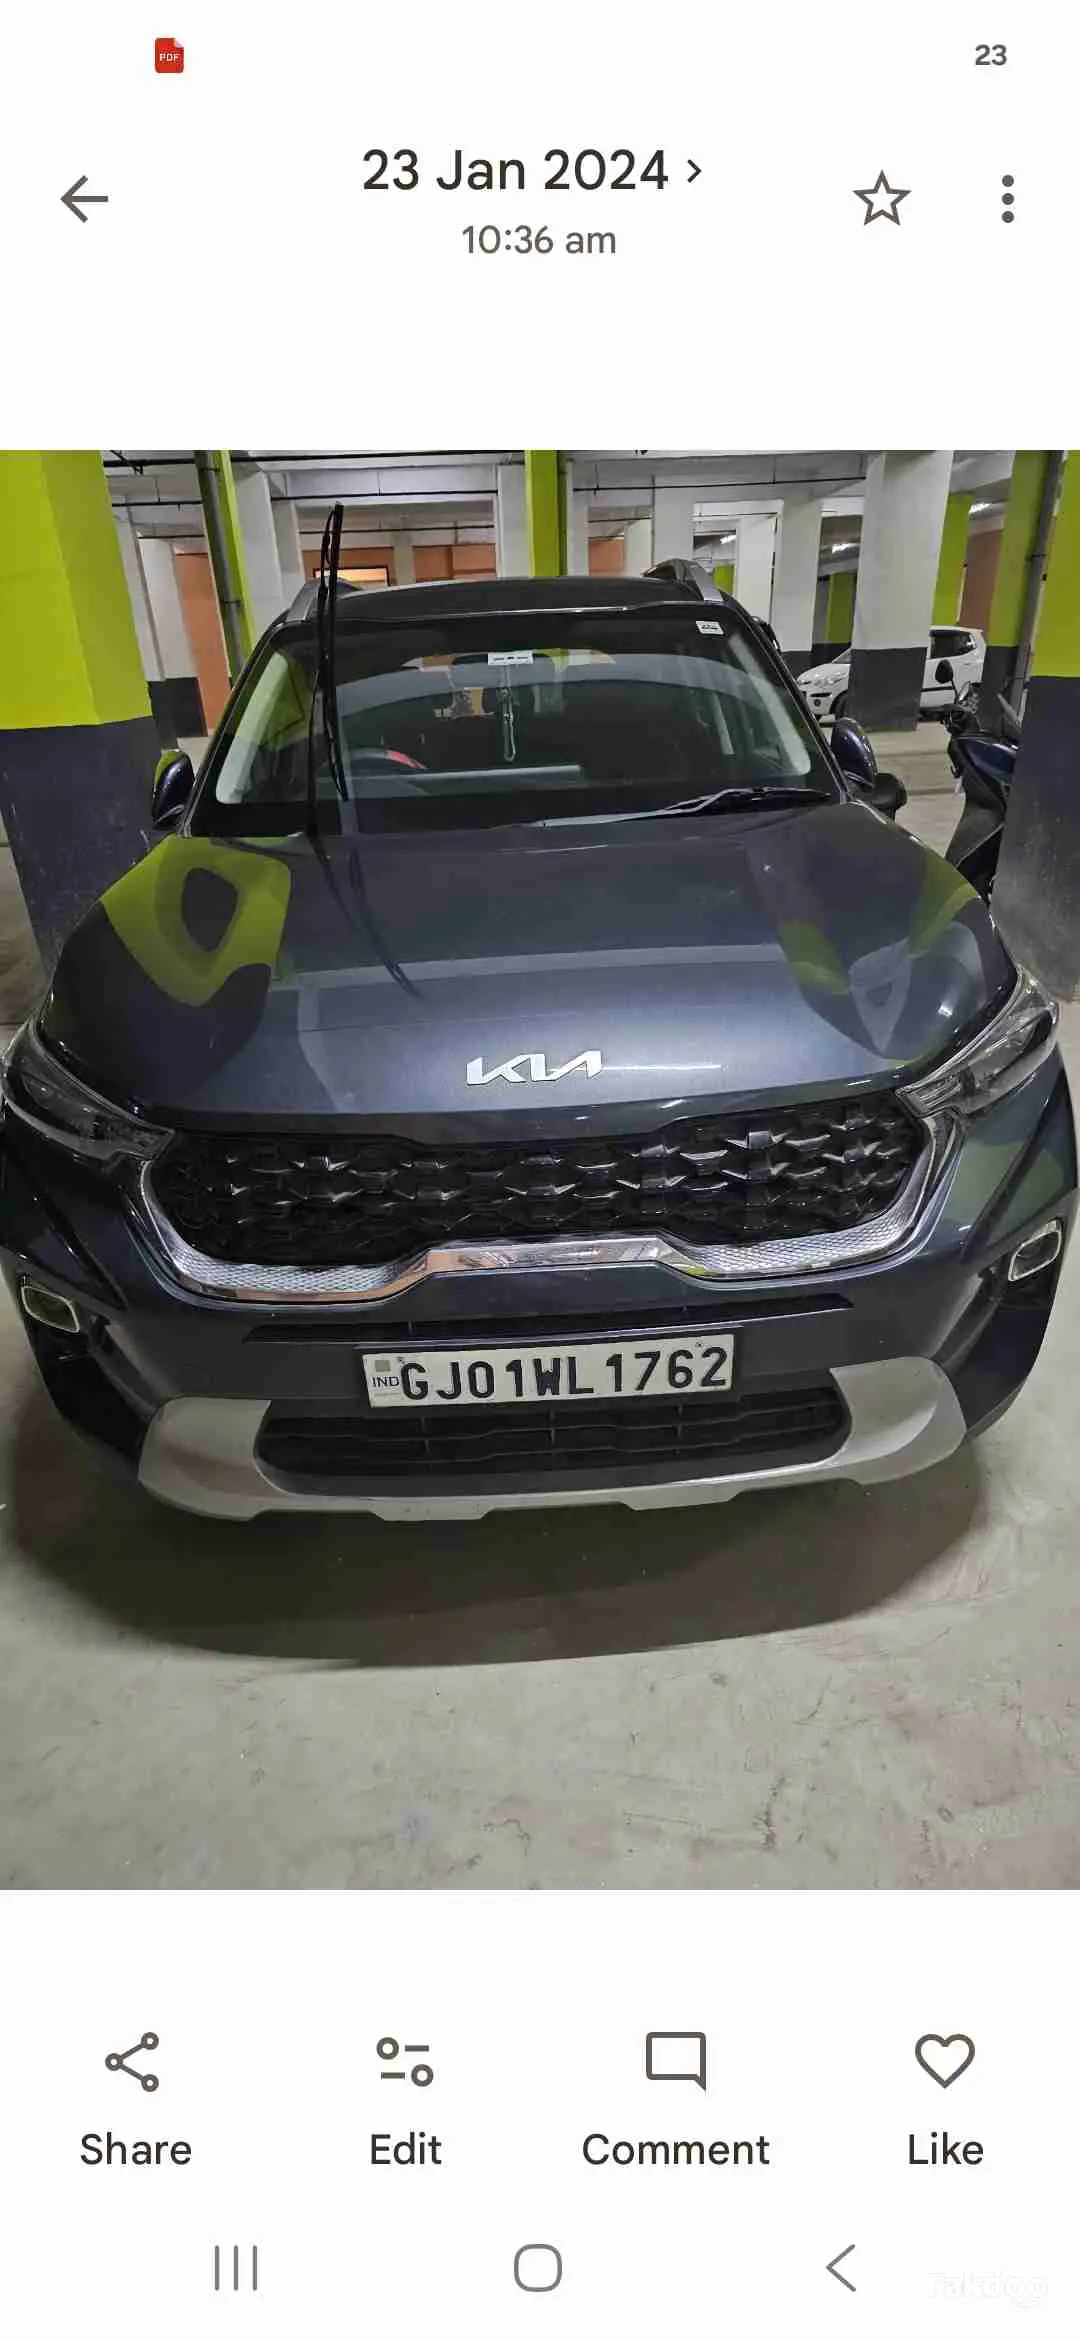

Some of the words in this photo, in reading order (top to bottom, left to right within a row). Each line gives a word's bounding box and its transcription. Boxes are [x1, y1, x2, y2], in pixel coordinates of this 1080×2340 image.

[159, 53, 180, 62] PDF
[975, 44, 1008, 66] 23
[362, 148, 419, 191] 23
[436, 149, 525, 191] Jan
[543, 148, 669, 191] 2024
[462, 224, 554, 255] 10:36
[565, 231, 616, 255] am
[371, 1376, 399, 1387] IND
[400, 1346, 728, 1401] GJ01WL1762
[80, 2131, 192, 2166] Share
[370, 2131, 442, 2166] Edit
[582, 2133, 770, 2166] Comment
[908, 2131, 984, 2166] Like
